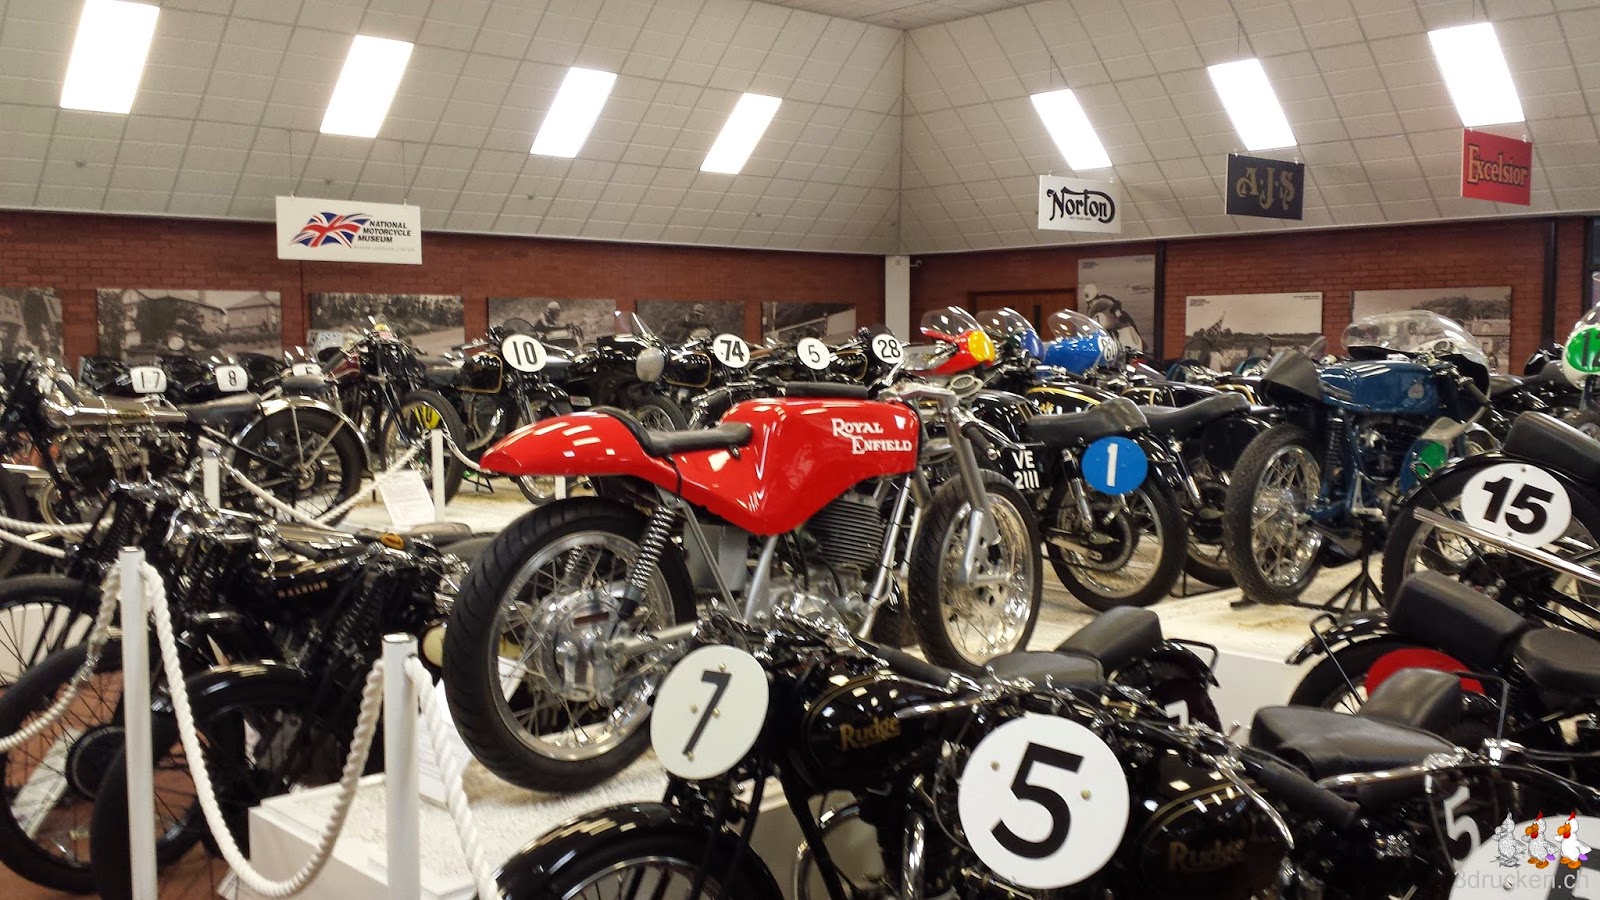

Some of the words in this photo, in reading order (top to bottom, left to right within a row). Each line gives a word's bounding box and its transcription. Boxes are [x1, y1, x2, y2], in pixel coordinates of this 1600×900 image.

[1467, 143, 1529, 187] Excelsior
[1046, 186, 1116, 224] Norton
[363, 228, 411, 237] MOTORCYCLE
[369, 220, 407, 229] NATIONAL
[358, 235, 393, 243] MUSEUM
[512, 341, 538, 365] 10
[720, 339, 745, 362] 74
[808, 344, 821, 363] 5
[877, 339, 900, 359] 28
[140, 371, 161, 389] 17
[228, 370, 237, 387] 8
[831, 418, 884, 438] ROYAL
[850, 435, 913, 455] ENFIELD
[1011, 450, 1035, 469] VE
[1106, 443, 1118, 487] 1
[1482, 476, 1554, 534] 15
[682, 670, 732, 756] 7
[990, 742, 1085, 859] 5
[1443, 785, 1481, 866] 5
